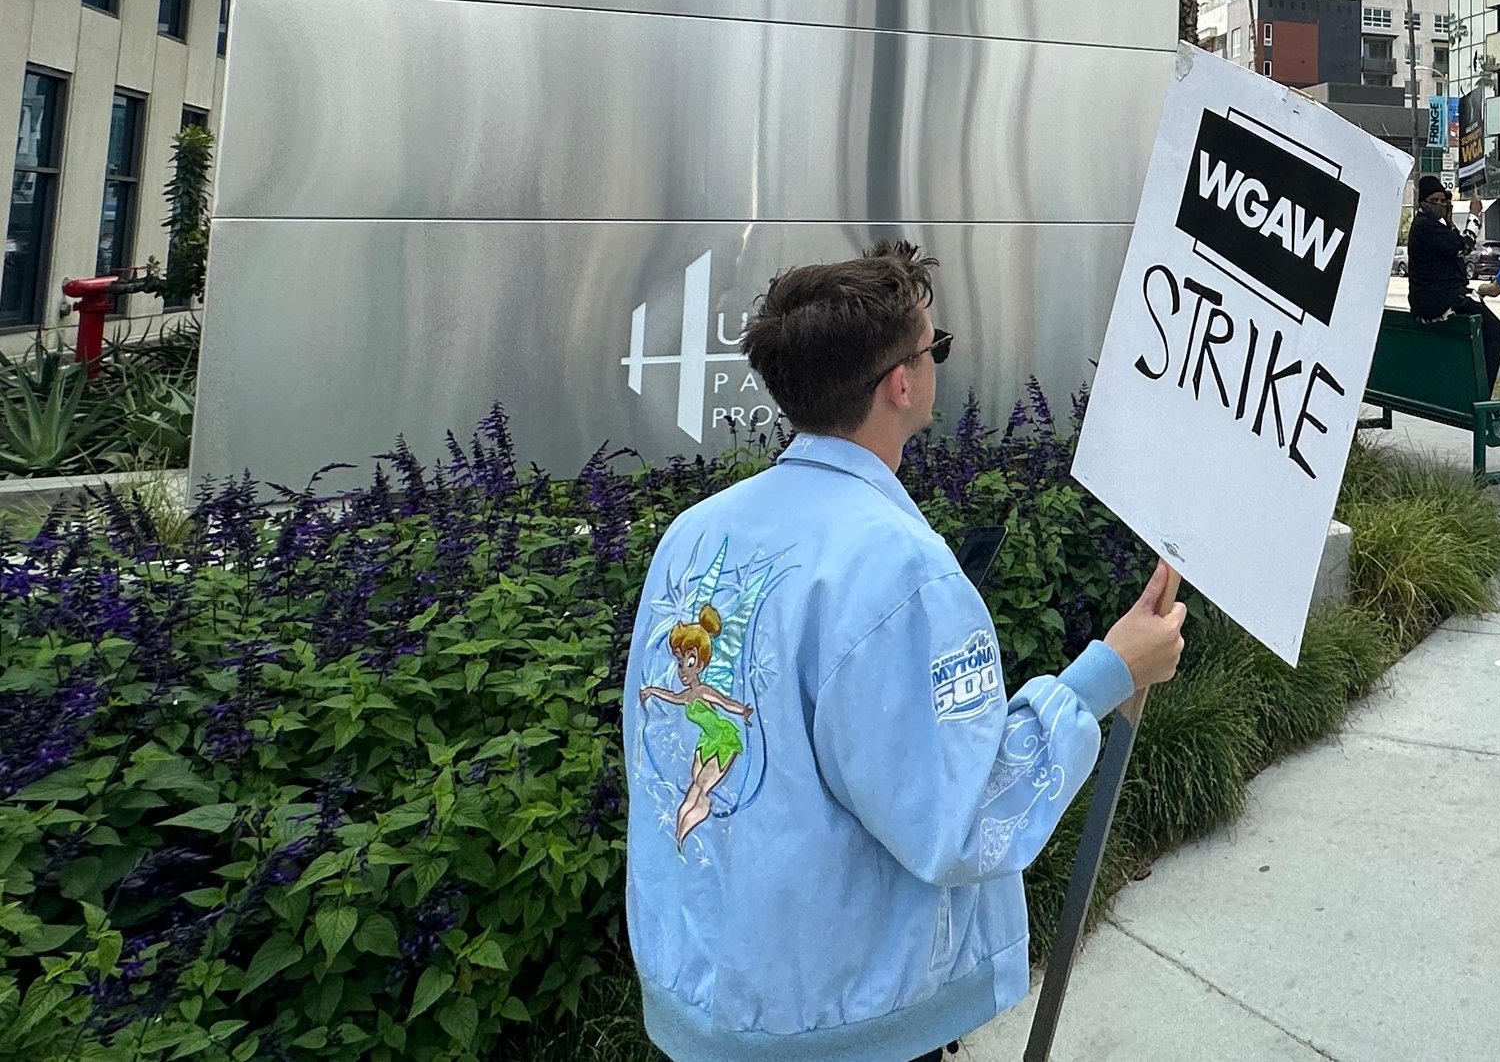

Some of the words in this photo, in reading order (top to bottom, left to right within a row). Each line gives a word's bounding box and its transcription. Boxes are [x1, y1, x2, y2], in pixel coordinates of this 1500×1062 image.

[1429, 102, 1439, 145] FRINGE
[1462, 138, 1483, 163] WGA
[1198, 149, 1345, 272] WGAW
[1135, 264, 1345, 480] STRIKE
[932, 646, 994, 687] DAYTONA
[934, 665, 999, 716] 500
